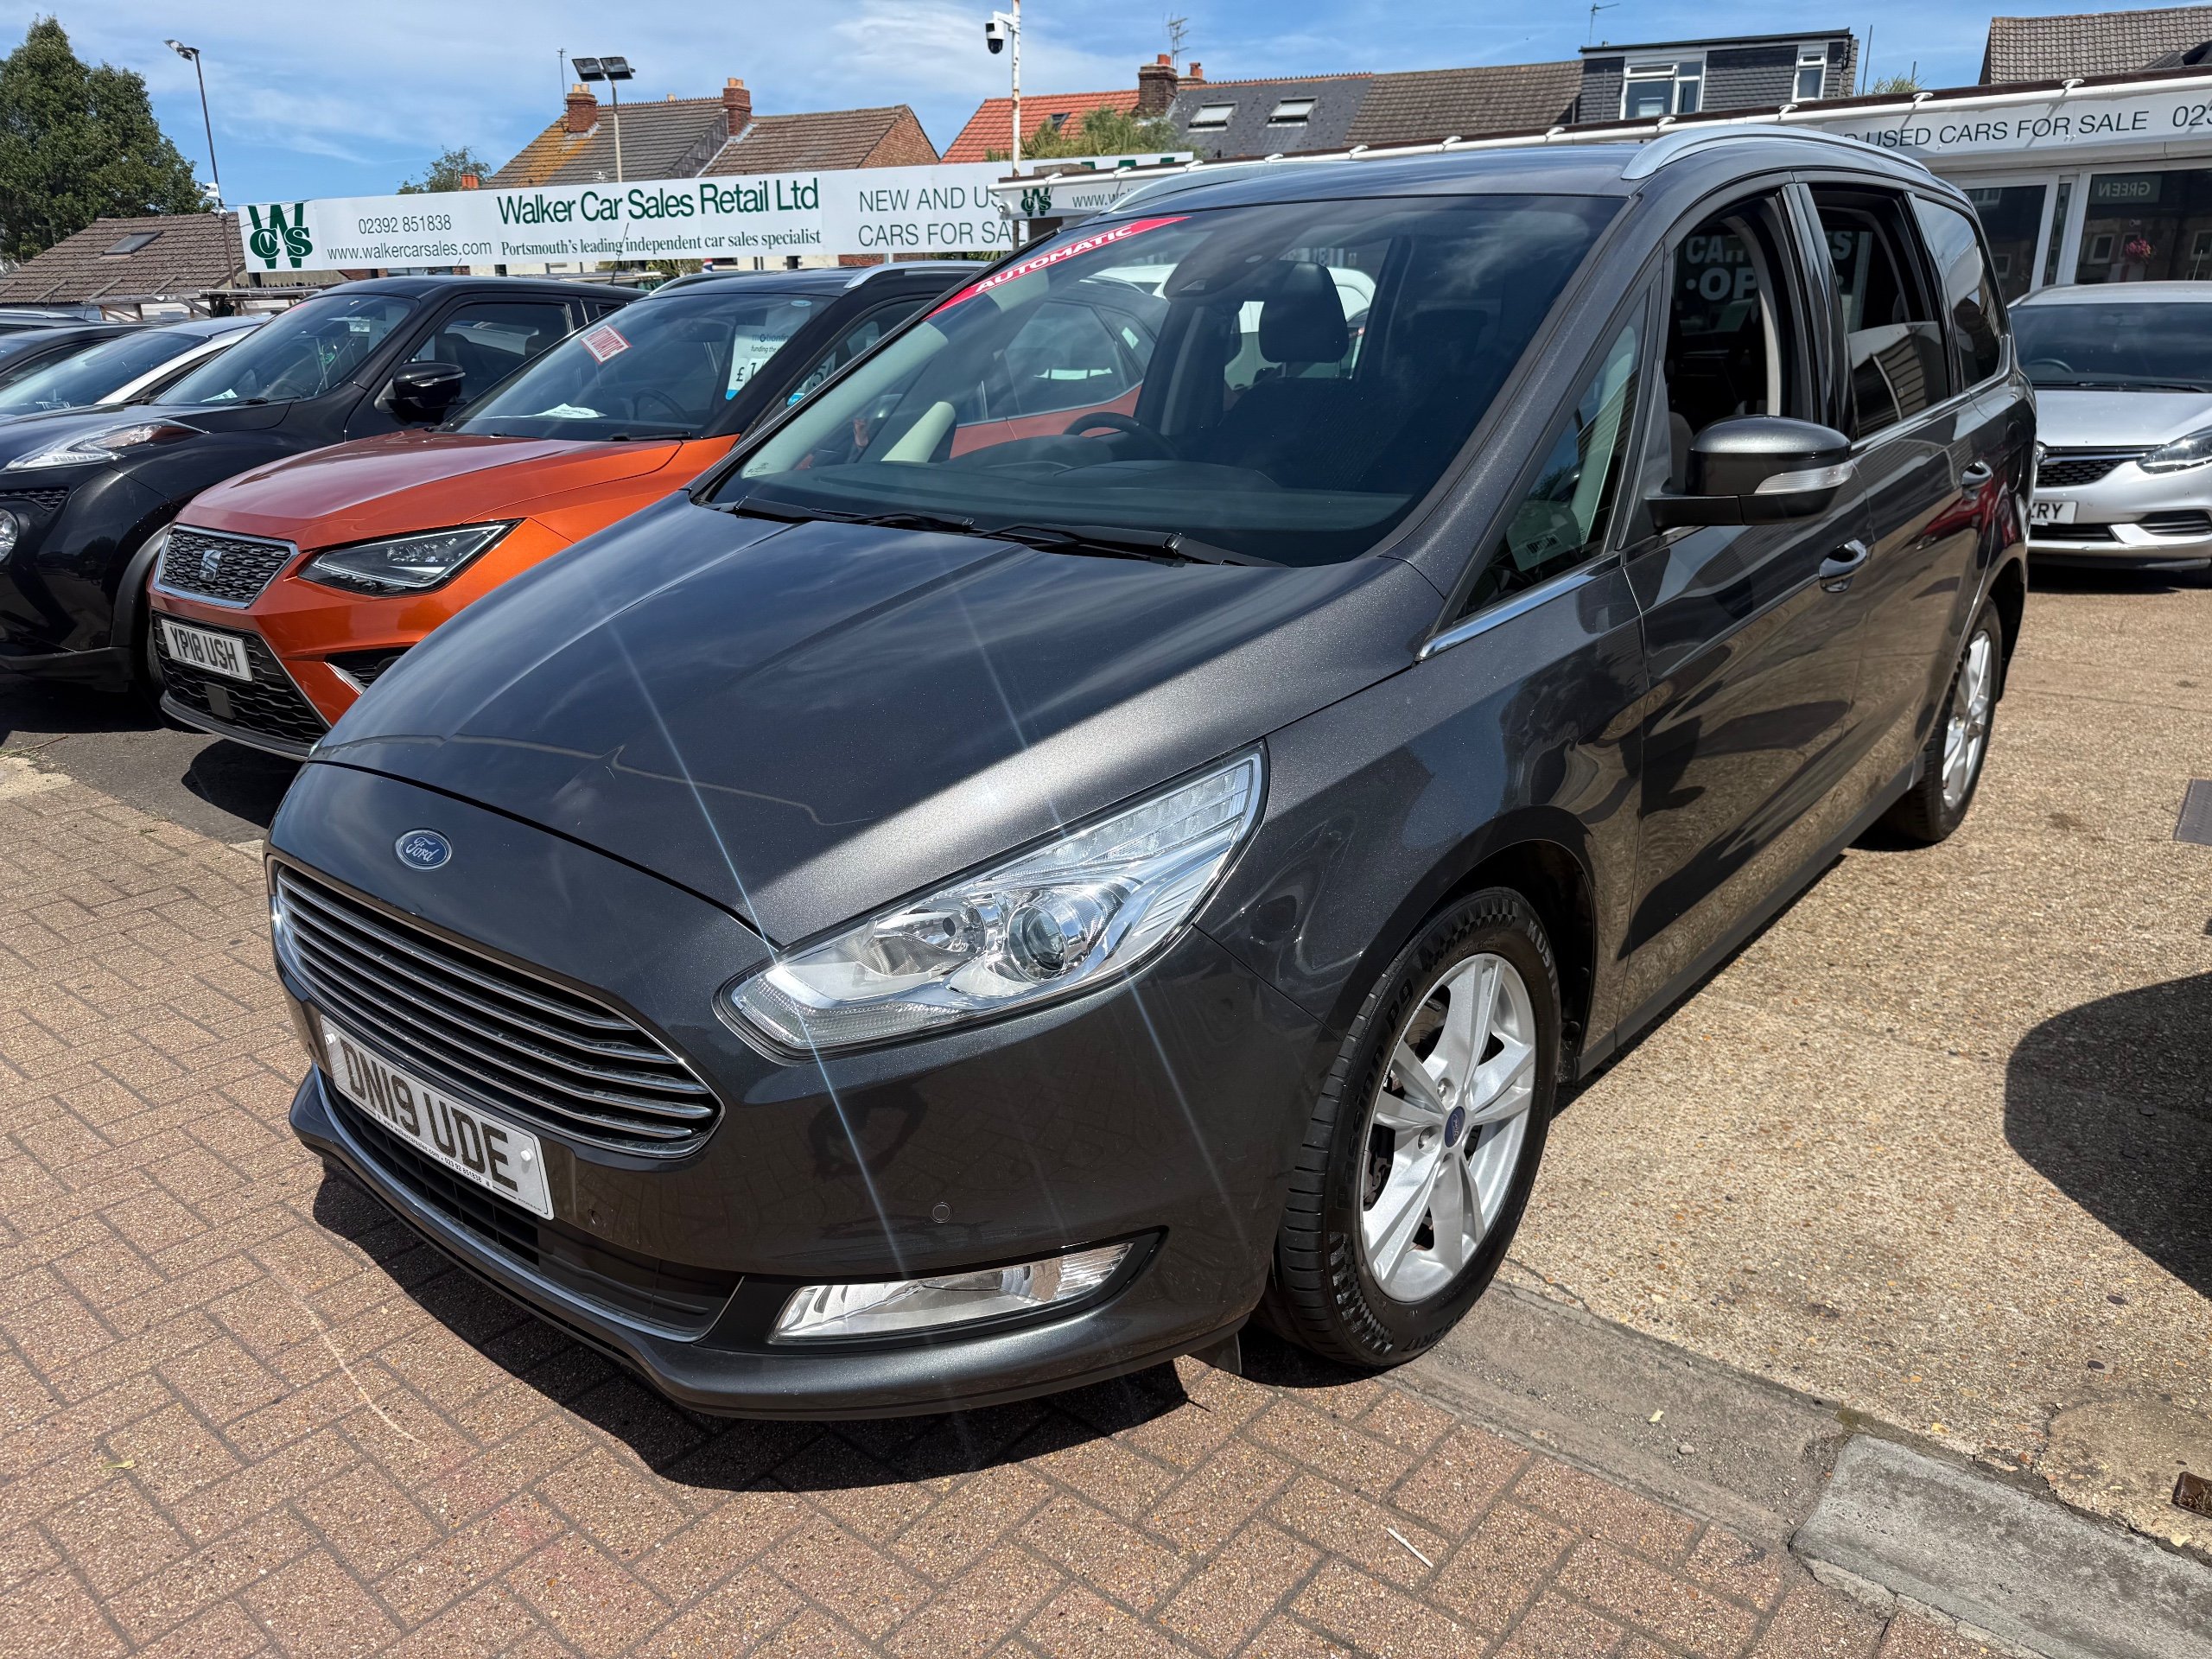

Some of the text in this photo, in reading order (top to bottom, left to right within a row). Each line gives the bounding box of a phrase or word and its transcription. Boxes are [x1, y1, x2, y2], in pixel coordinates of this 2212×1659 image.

[1939, 122, 2007, 144] CARS
[2017, 117, 2070, 139] FOR
[2078, 111, 2150, 134] SALE
[497, 177, 819, 225] Walker Car Sales Retail Ltd
[859, 188, 910, 213] NEW
[917, 187, 966, 210] AND
[358, 214, 452, 235] 02392 851838
[858, 223, 918, 247] CARS
[927, 221, 974, 245] FOR
[327, 239, 493, 260] www.walkercarsales.com
[580, 238, 623, 256] leading
[626, 234, 702, 254] independent
[704, 234, 725, 248] car
[728, 232, 759, 247] sales
[760, 228, 821, 249] specialist
[976, 226, 1133, 293] AUTOMATIC
[751, 345, 768, 353] funding
[169, 626, 205, 663] YP18
[203, 636, 240, 673] USH
[405, 836, 440, 862] Ford
[339, 1039, 518, 1192] DN19 UDE
